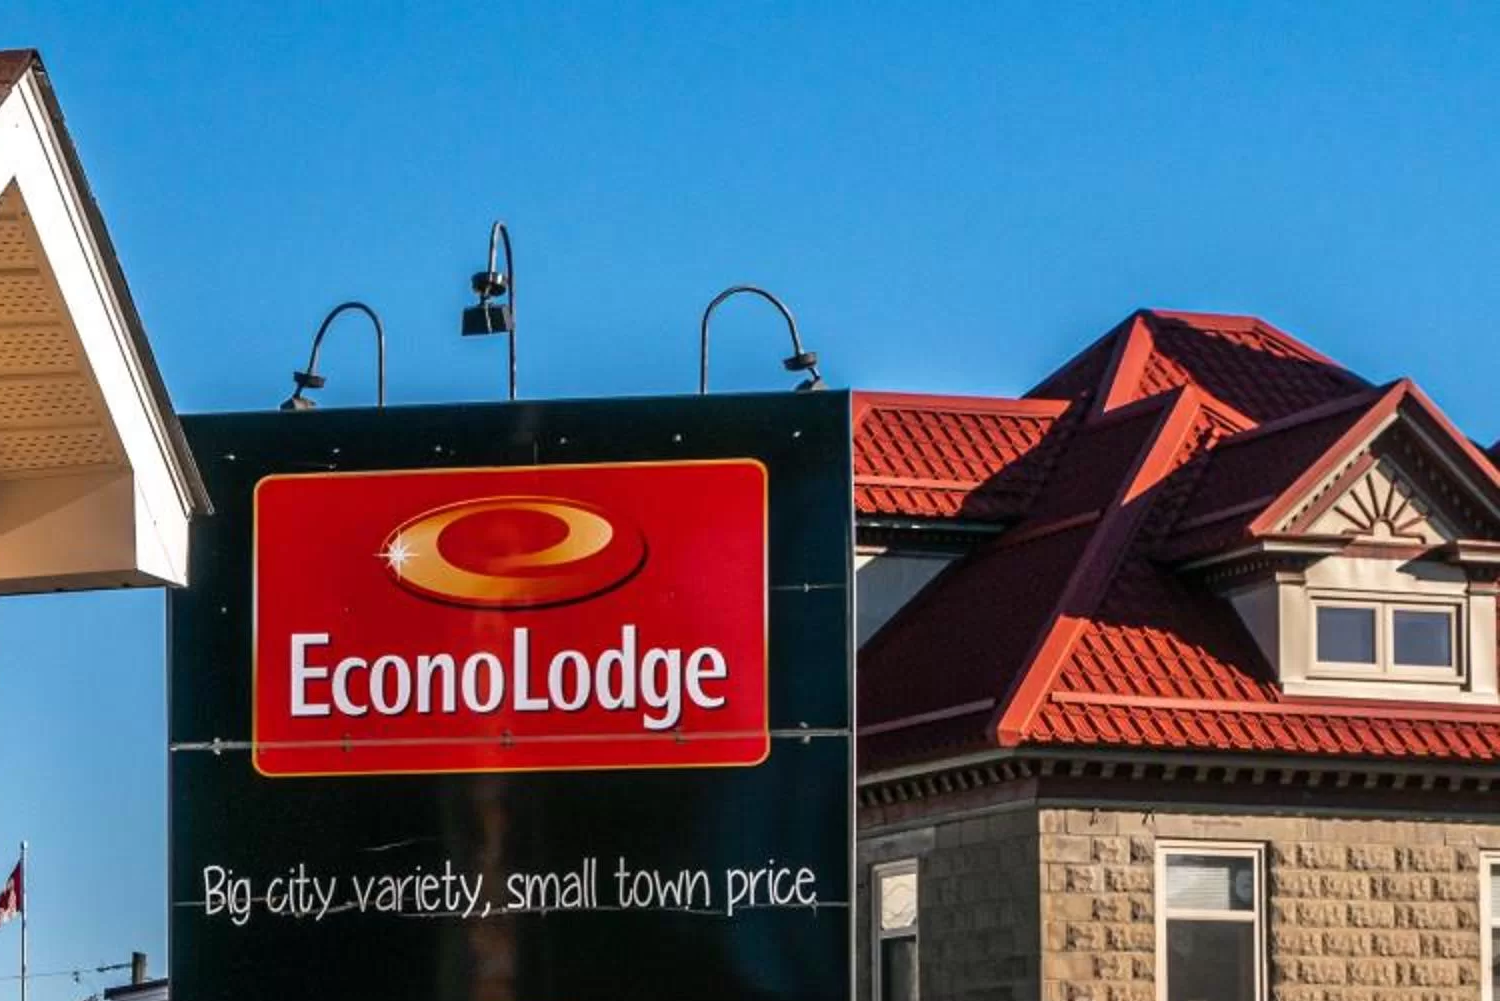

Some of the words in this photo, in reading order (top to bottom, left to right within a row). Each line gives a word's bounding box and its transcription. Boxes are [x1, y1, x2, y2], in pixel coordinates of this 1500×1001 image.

[289, 625, 727, 730] EconoLodge
[203, 865, 250, 925] Big
[267, 863, 336, 921] city
[353, 860, 491, 919] variety,
[507, 857, 597, 909] small
[614, 857, 710, 911] town
[727, 859, 817, 917] price
